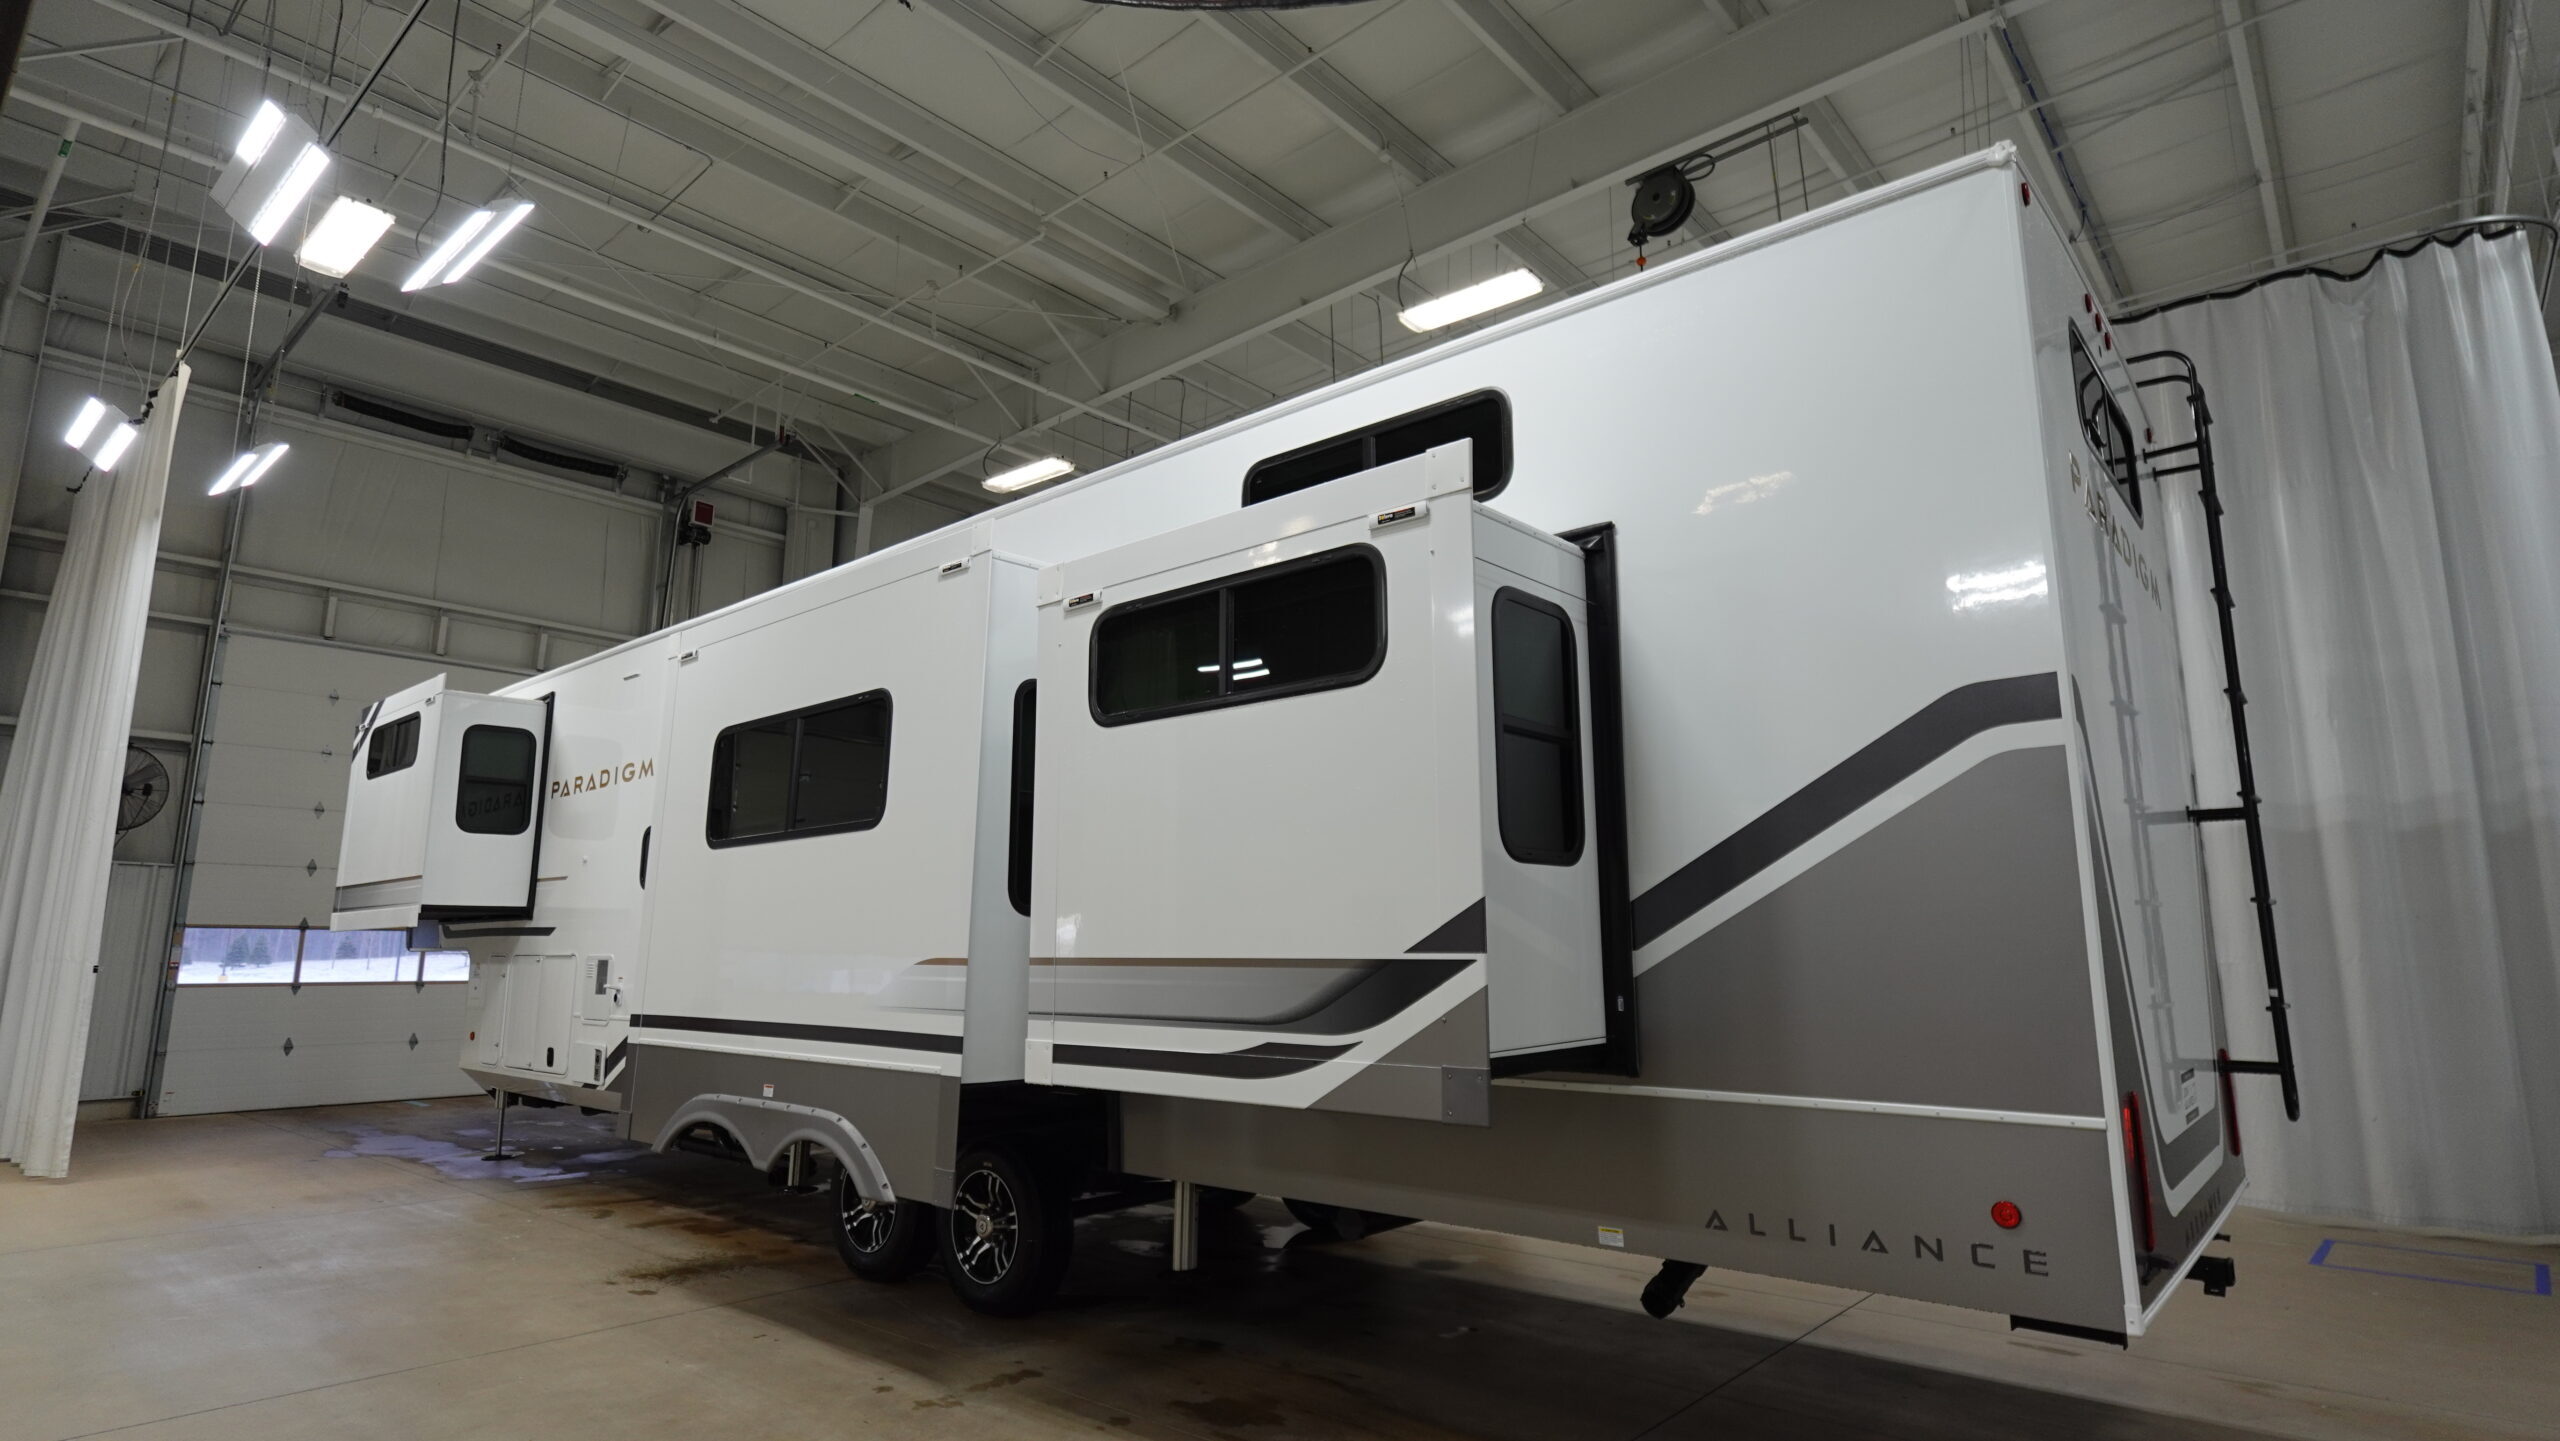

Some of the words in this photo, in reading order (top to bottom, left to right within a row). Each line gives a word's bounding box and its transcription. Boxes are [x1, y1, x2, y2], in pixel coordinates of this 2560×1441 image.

[2069, 449, 2162, 612] PARADIGM
[551, 758, 655, 799] PARADIGM
[1705, 1209, 2049, 1277] ALLIANCE
